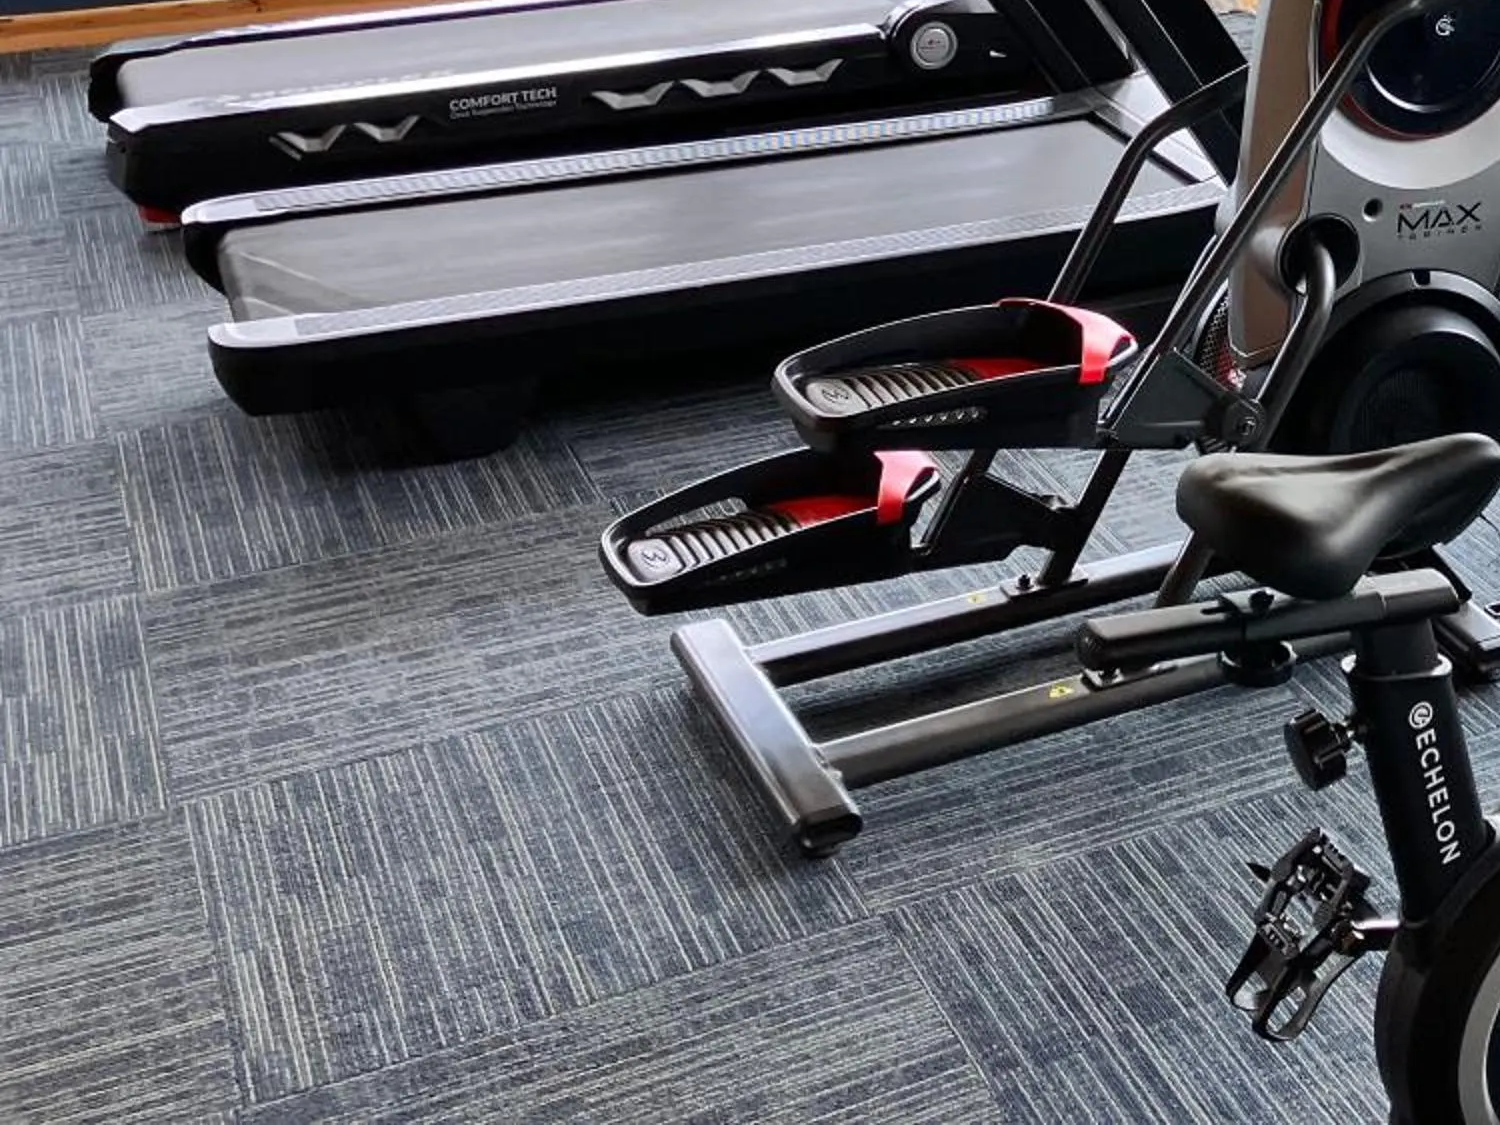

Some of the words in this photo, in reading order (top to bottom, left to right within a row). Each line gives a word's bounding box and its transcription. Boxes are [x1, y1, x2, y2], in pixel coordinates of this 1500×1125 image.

[449, 92, 519, 112] COMFORT
[521, 86, 558, 103] TECH
[1397, 201, 1482, 234] MAX
[1415, 727, 1462, 865] ECHELON
